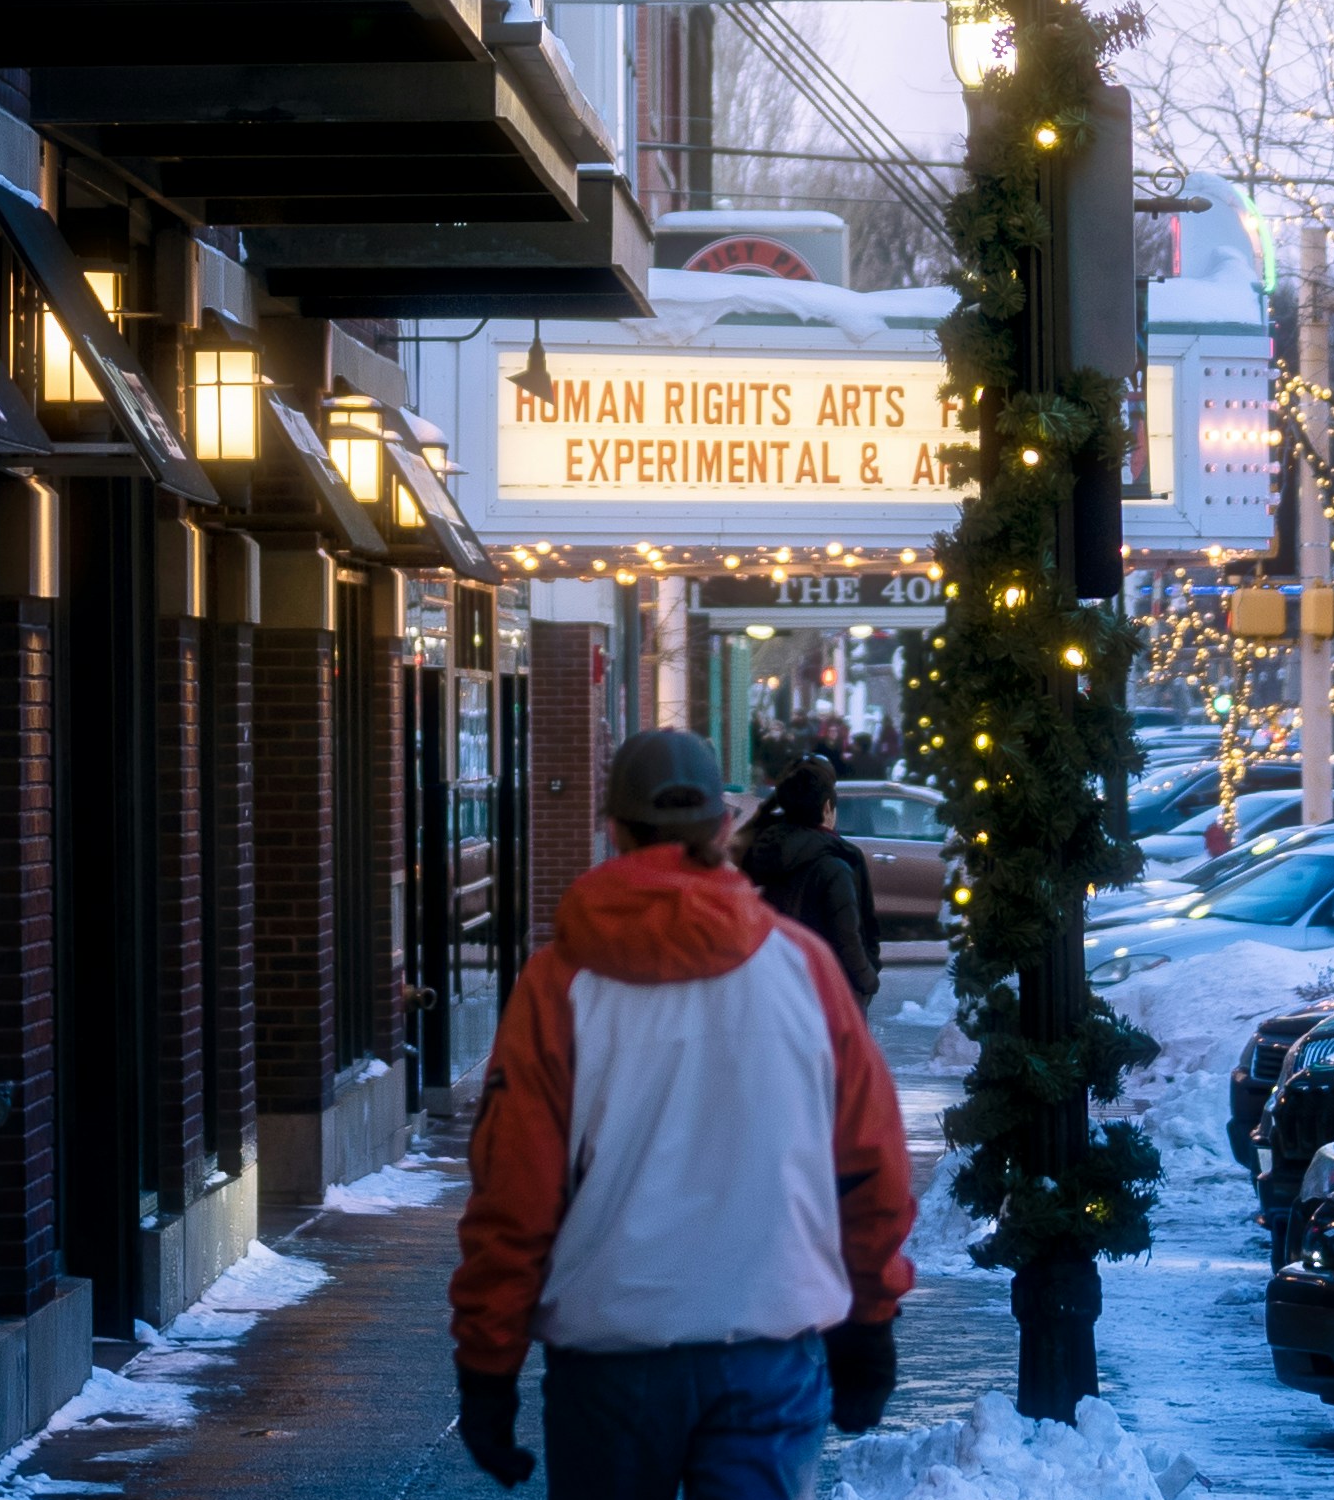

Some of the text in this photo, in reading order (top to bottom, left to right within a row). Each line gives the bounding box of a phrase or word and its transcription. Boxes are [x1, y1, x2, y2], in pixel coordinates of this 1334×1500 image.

[772, 250, 813, 281] PI
[516, 380, 645, 423] HUMAN
[665, 381, 792, 426] RIGHTS
[816, 384, 905, 428] ARTS
[566, 438, 840, 484] EXPERIMENTAL
[860, 441, 883, 484] &
[770, 576, 942, 604] THE 40
